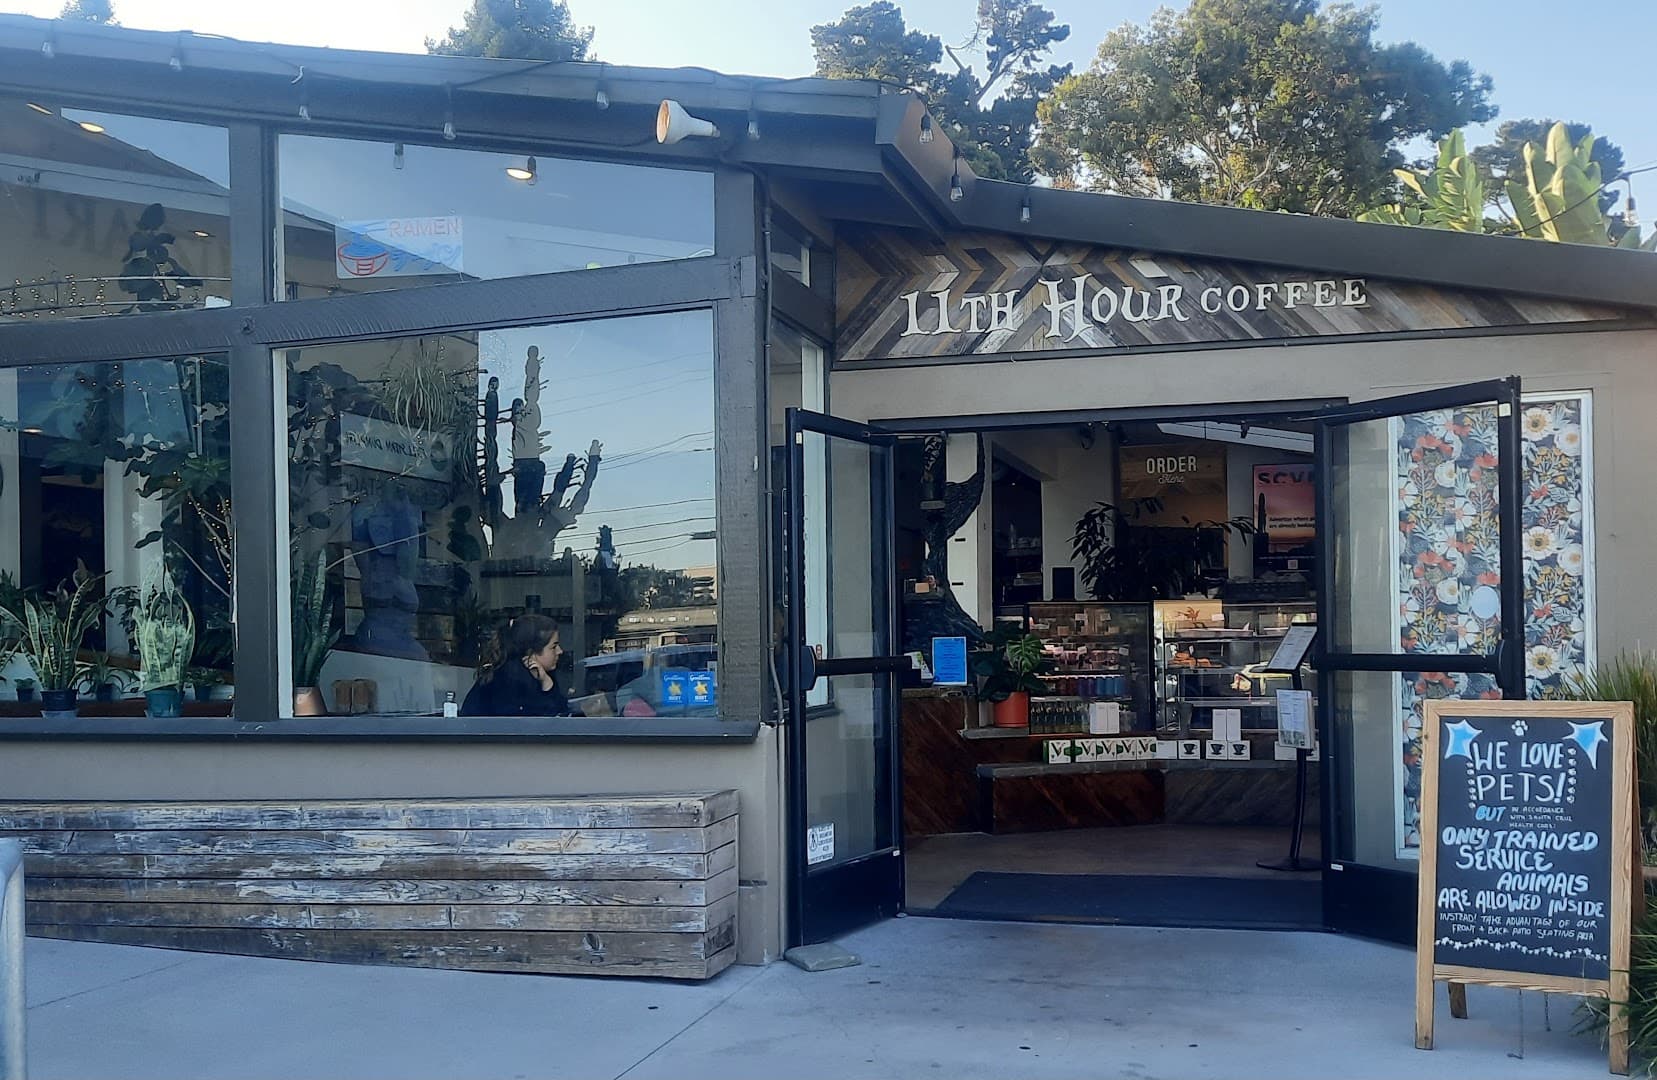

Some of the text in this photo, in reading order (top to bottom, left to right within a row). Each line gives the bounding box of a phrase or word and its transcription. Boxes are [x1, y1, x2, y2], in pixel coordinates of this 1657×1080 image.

[388, 218, 460, 237] RAMEN
[900, 273, 1368, 343] 11TH HOUR COFFEE
[1146, 455, 1198, 474] ORDER
[1472, 741, 1564, 770] WE LOVE
[1477, 772, 1567, 803] PETS!
[1475, 805, 1507, 822] BUT
[1442, 827, 1598, 851] ONLY TRAINED
[1456, 845, 1553, 871] SERVICE
[1497, 872, 1589, 897] ANIMALS
[1438, 888, 1605, 917] ARE ALLOWED INSIDE
[1452, 923, 1476, 934] FRONT
[1487, 925, 1509, 935] BACK
[1536, 929, 1576, 939] SEATING
[1481, 915, 1502, 925] TAKE
[1505, 917, 1553, 927] ADVANTAGE
[1558, 919, 1570, 928] OF
[1576, 920, 1598, 929] OUR
